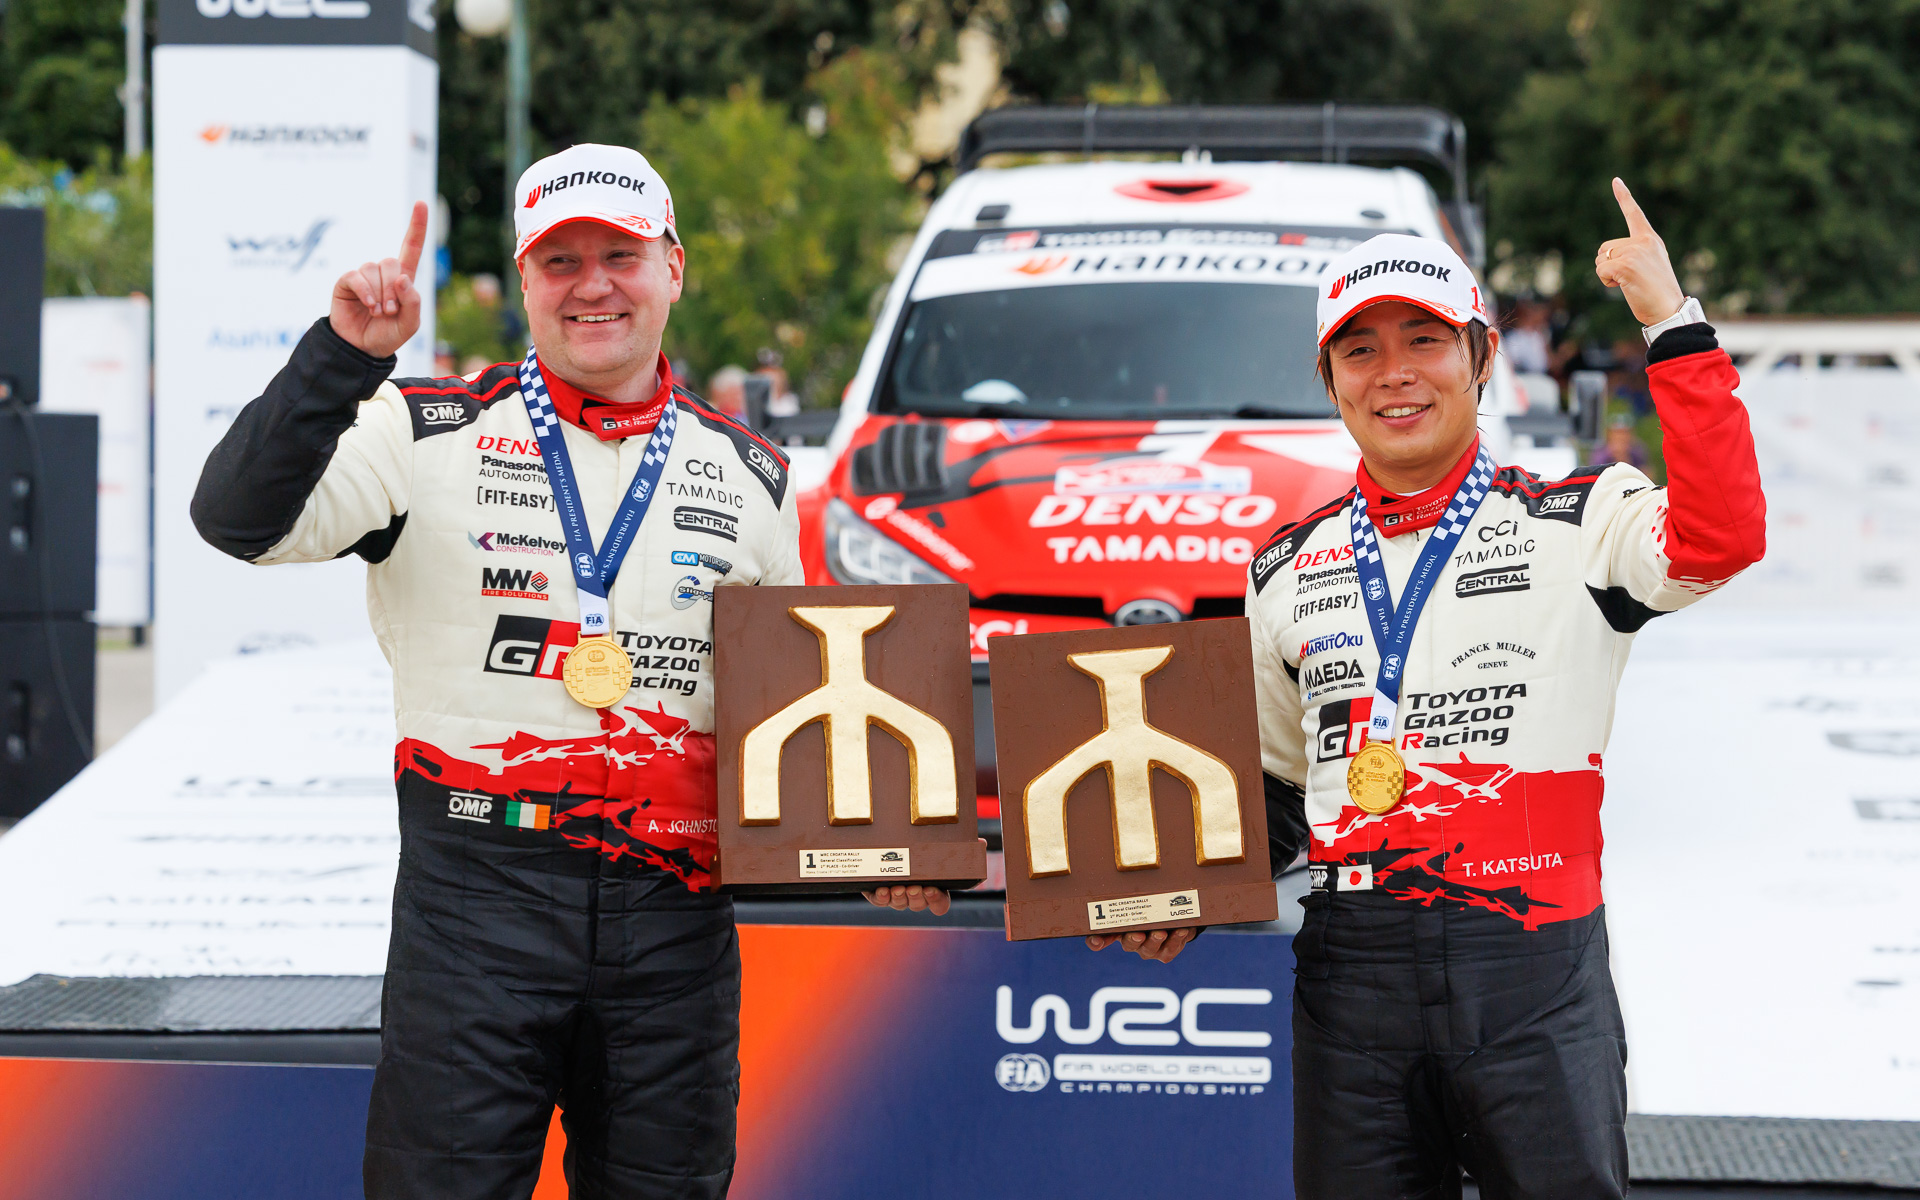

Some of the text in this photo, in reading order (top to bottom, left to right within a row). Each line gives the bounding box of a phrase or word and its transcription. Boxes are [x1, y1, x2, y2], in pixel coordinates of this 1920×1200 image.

[1072, 253, 1329, 275] Hankoo
[422, 405, 465, 421] OMP
[476, 434, 542, 457] DENS
[551, 450, 565, 477] MEDAL
[748, 448, 781, 482] OMP
[478, 468, 551, 485] AUTOMOTIV
[632, 478, 651, 501] FIA
[666, 482, 744, 509] TAMADIC
[624, 509, 636, 521] FIA
[1028, 494, 1278, 529] DENSO
[1416, 507, 1446, 520] Racing
[1539, 494, 1579, 513] OMP
[573, 528, 582, 542] FIA
[673, 511, 738, 536] CENTRAL
[495, 545, 554, 557] CONSTRUCTION
[496, 532, 568, 554] McKelvey
[1046, 535, 1254, 565] TAMADIC
[1454, 539, 1536, 568] TAMADIC
[577, 554, 593, 578] FIA
[1254, 540, 1293, 577] OMP
[1294, 544, 1353, 571] DENS
[1455, 572, 1530, 592] CENTRAL
[482, 589, 549, 600] FIRE SOLUTIONS
[1395, 629, 1405, 644] FIA
[1420, 553, 1438, 579] MEDAL
[585, 616, 604, 625] FIA
[616, 630, 712, 656] TOYOTA
[1451, 641, 1537, 668] FRANCK MULLER
[1304, 658, 1365, 690] MAEDA
[1385, 655, 1400, 680] FIA
[630, 673, 698, 696] acing
[1406, 683, 1527, 710] TOYOTA
[1373, 717, 1388, 727] FIA
[1403, 705, 1515, 731] GAZOO
[1400, 727, 1510, 751] Racing
[449, 796, 492, 817] OMP
[647, 819, 663, 833] A.
[806, 853, 817, 869] 1
[1462, 852, 1564, 877] T. KATSUTA
[1095, 904, 1106, 920] 1
[1170, 908, 1194, 917] WRC
[995, 984, 1273, 1047] WRC
[1001, 1058, 1264, 1087] FIA FIA WORLD RALLY
[1059, 1082, 1265, 1096] CHAMPIONSHIP
